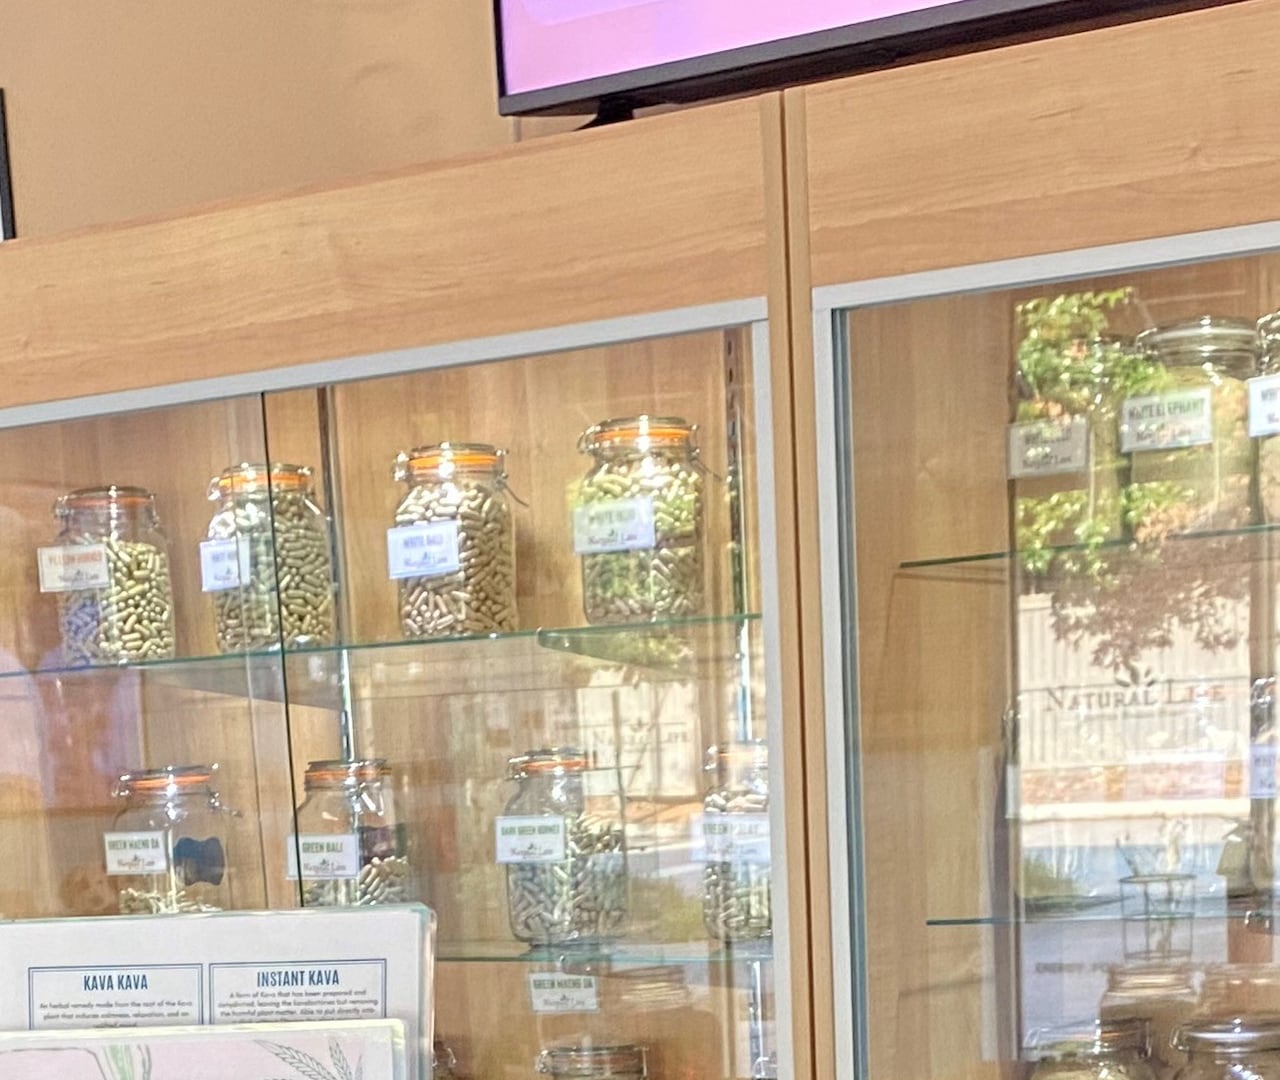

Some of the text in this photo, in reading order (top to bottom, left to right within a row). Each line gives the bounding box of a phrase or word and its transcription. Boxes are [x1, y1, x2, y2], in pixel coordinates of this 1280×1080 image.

[302, 842, 325, 853] GREEN
[83, 974, 148, 991] KAVA KAVA
[257, 969, 340, 987] INSTANT KAVA
